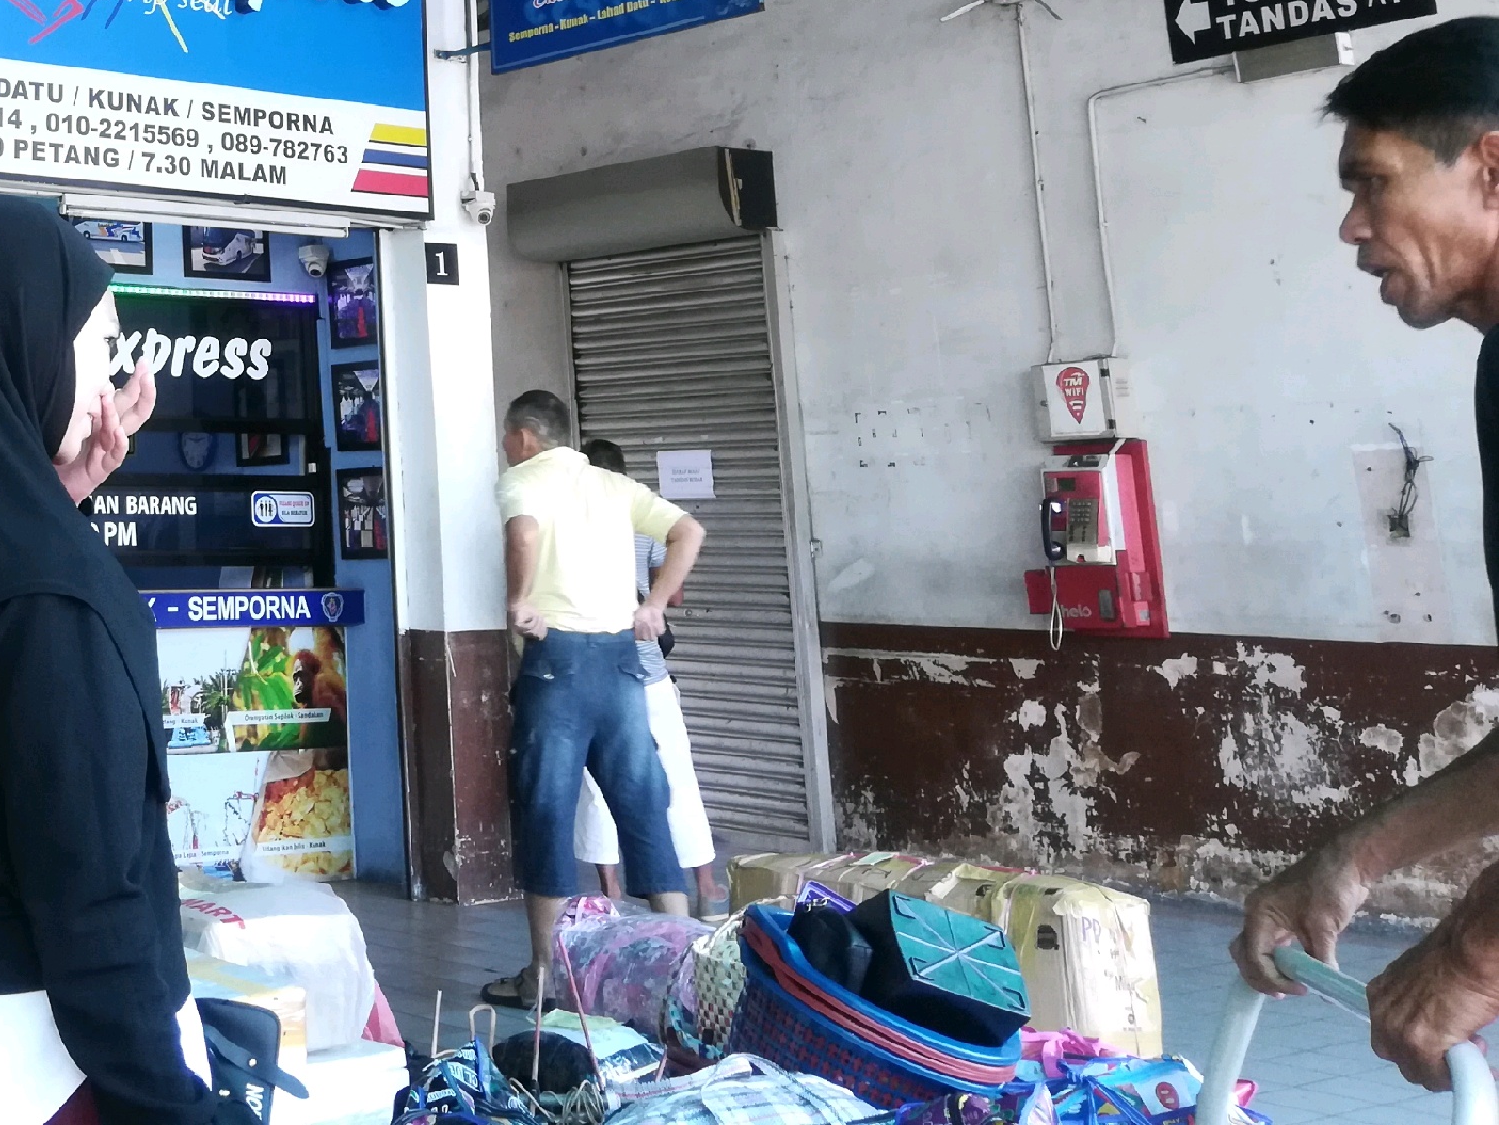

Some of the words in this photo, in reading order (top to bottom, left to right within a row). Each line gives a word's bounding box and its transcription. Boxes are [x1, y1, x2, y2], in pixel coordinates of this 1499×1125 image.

[74, 83, 80, 107] /
[88, 86, 179, 119] KUNAK
[187, 99, 193, 120] /
[201, 101, 334, 136] SEMPORNA
[45, 113, 200, 149] 010-2215569
[220, 131, 349, 165] 089-782763
[13, 138, 121, 169] PETANG
[128, 150, 134, 171] /
[140, 151, 192, 176] 7.30
[201, 158, 287, 186] MALAM
[435, 251, 448, 276] 1
[125, 495, 198, 516] BARANG
[104, 521, 138, 547] PM
[187, 595, 312, 622] SEMPORNA
